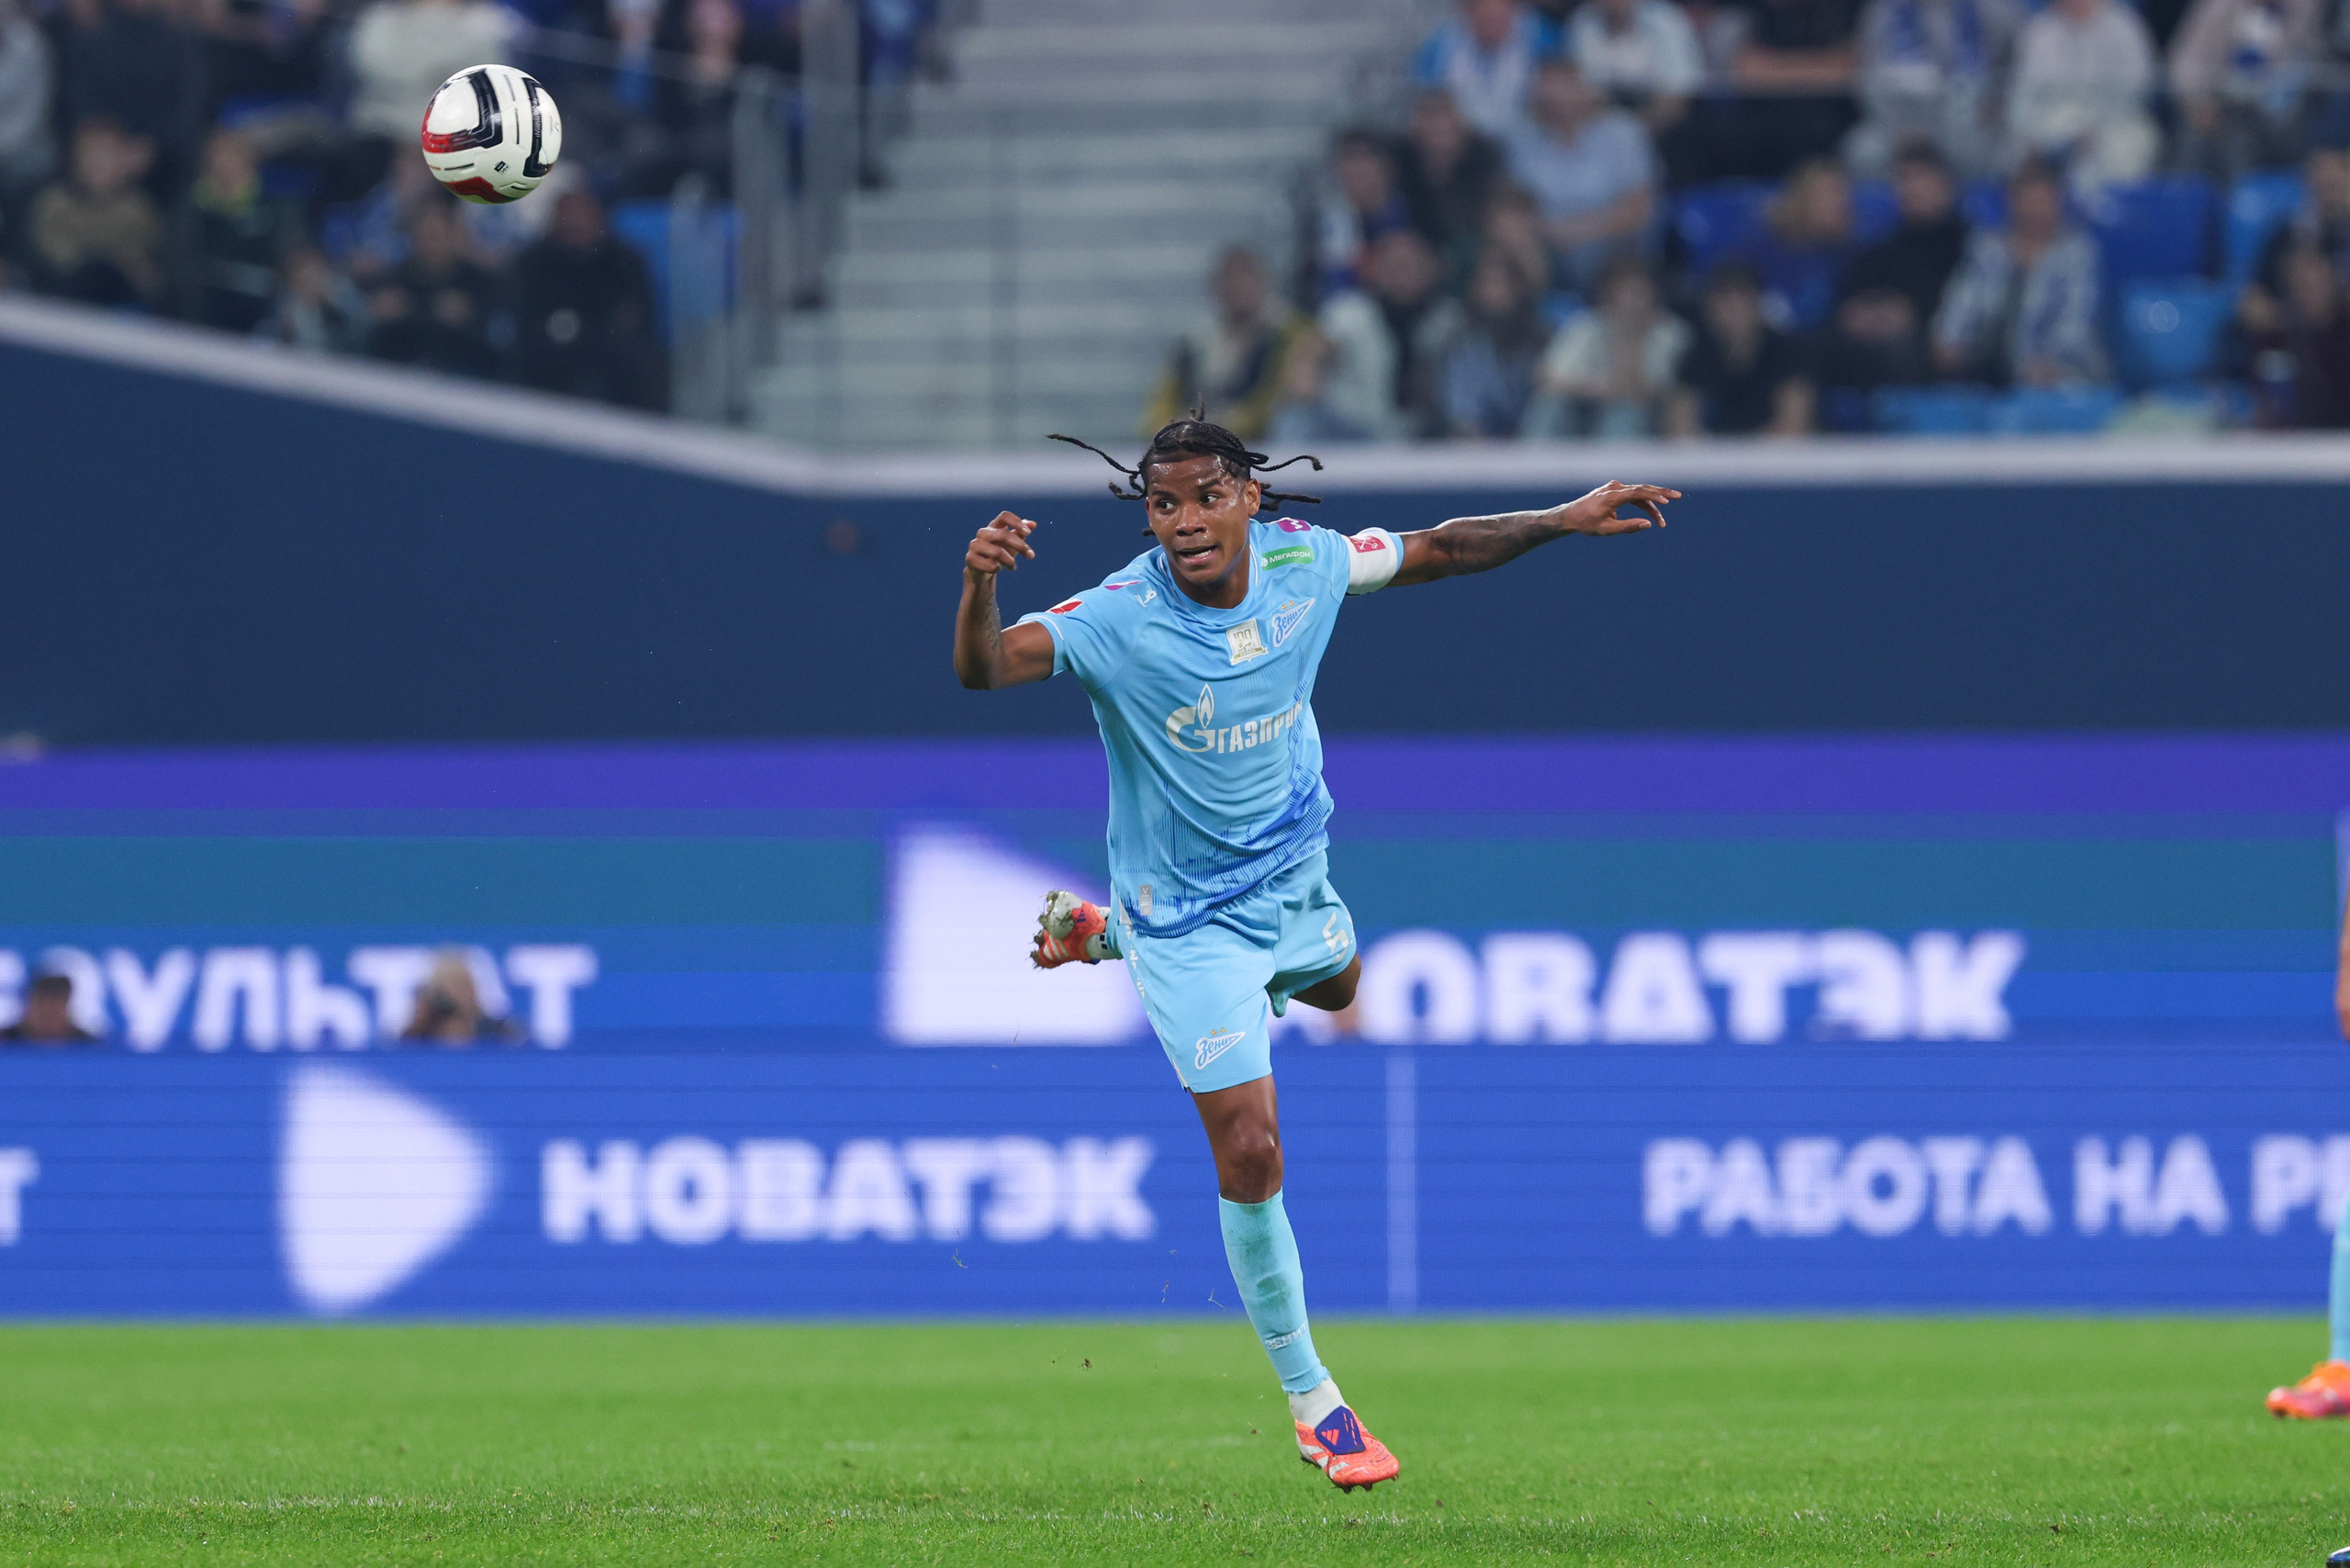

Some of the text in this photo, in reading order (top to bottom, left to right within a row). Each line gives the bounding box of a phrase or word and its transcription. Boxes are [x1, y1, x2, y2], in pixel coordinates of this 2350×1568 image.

[1269, 551, 1311, 564] МЕГАФОН
[1269, 929, 2025, 1045] ОВАТЭК
[542, 1137, 1157, 1245] НОВАТЭК
[1643, 1135, 2054, 1238] РАБОТА
[2073, 1135, 2231, 1237] НА
